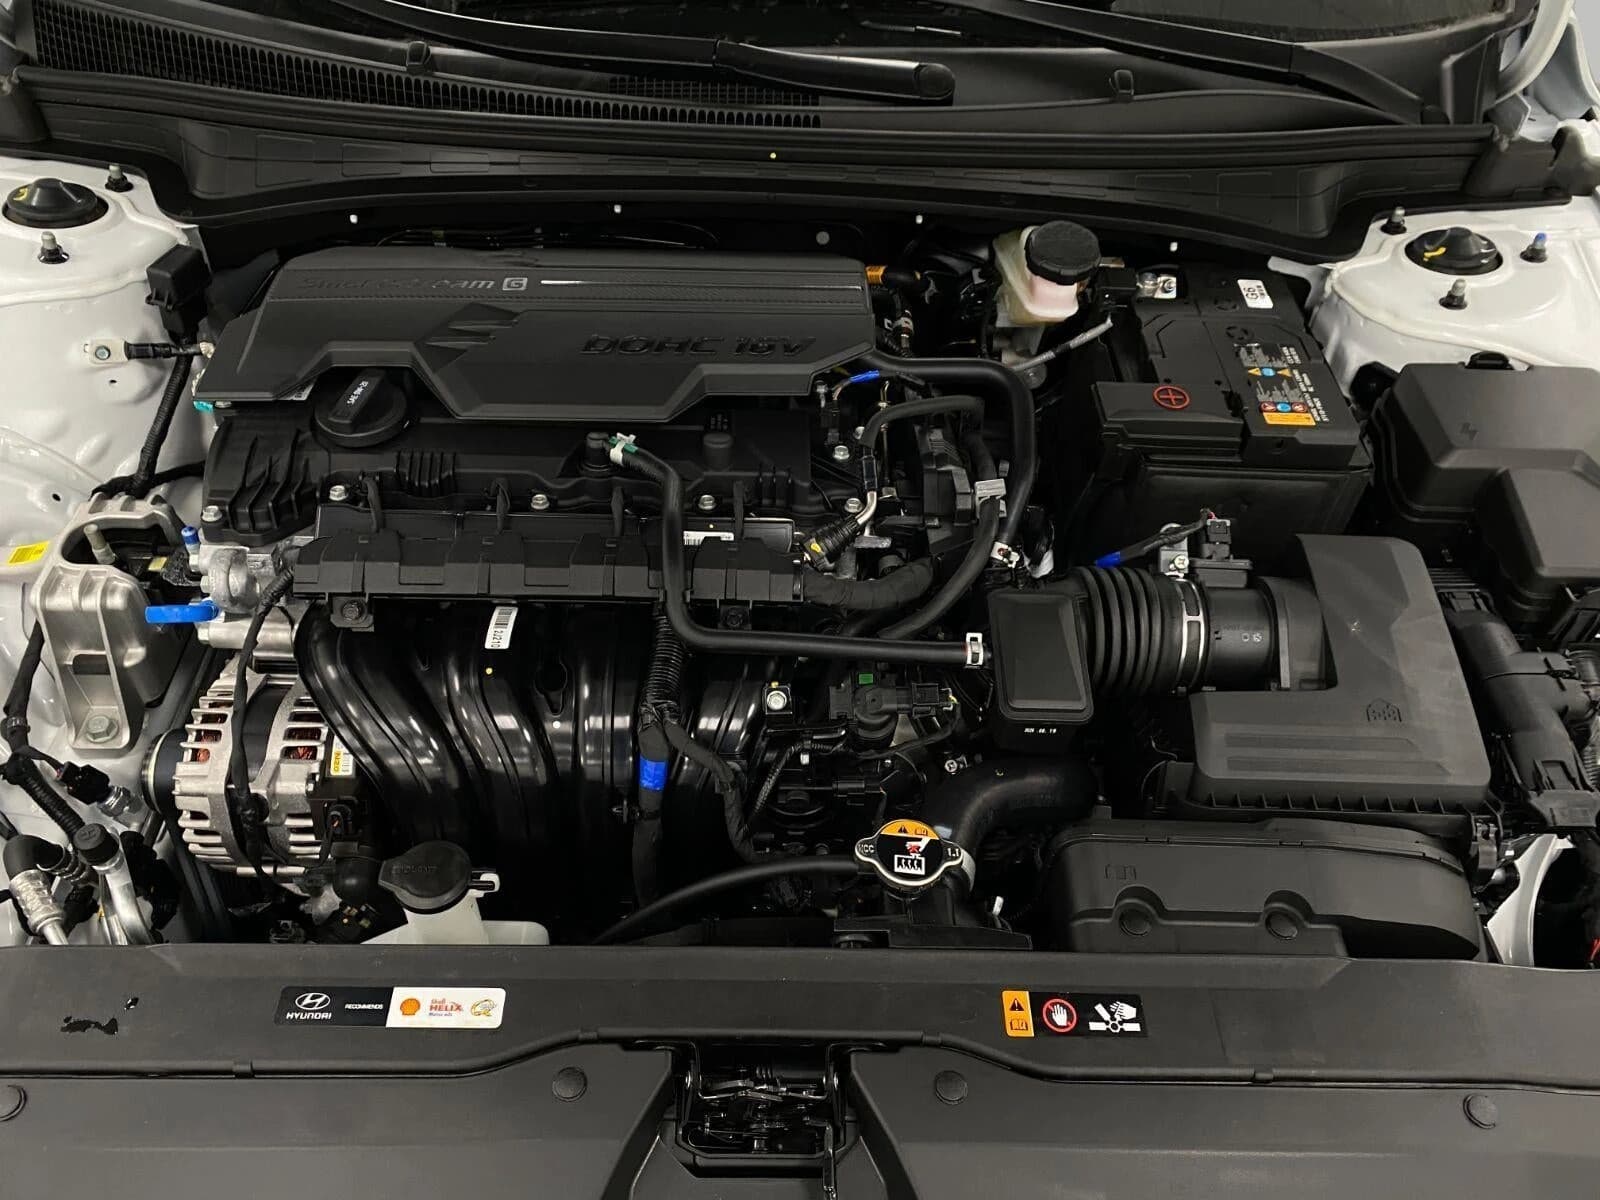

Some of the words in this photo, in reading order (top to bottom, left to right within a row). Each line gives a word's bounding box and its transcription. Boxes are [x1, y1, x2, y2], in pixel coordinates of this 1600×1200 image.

[579, 334, 726, 356] DOHC
[733, 335, 818, 357] 16V
[429, 1003, 464, 1012] HELIX
[286, 1012, 333, 1020] HYUNDAI
